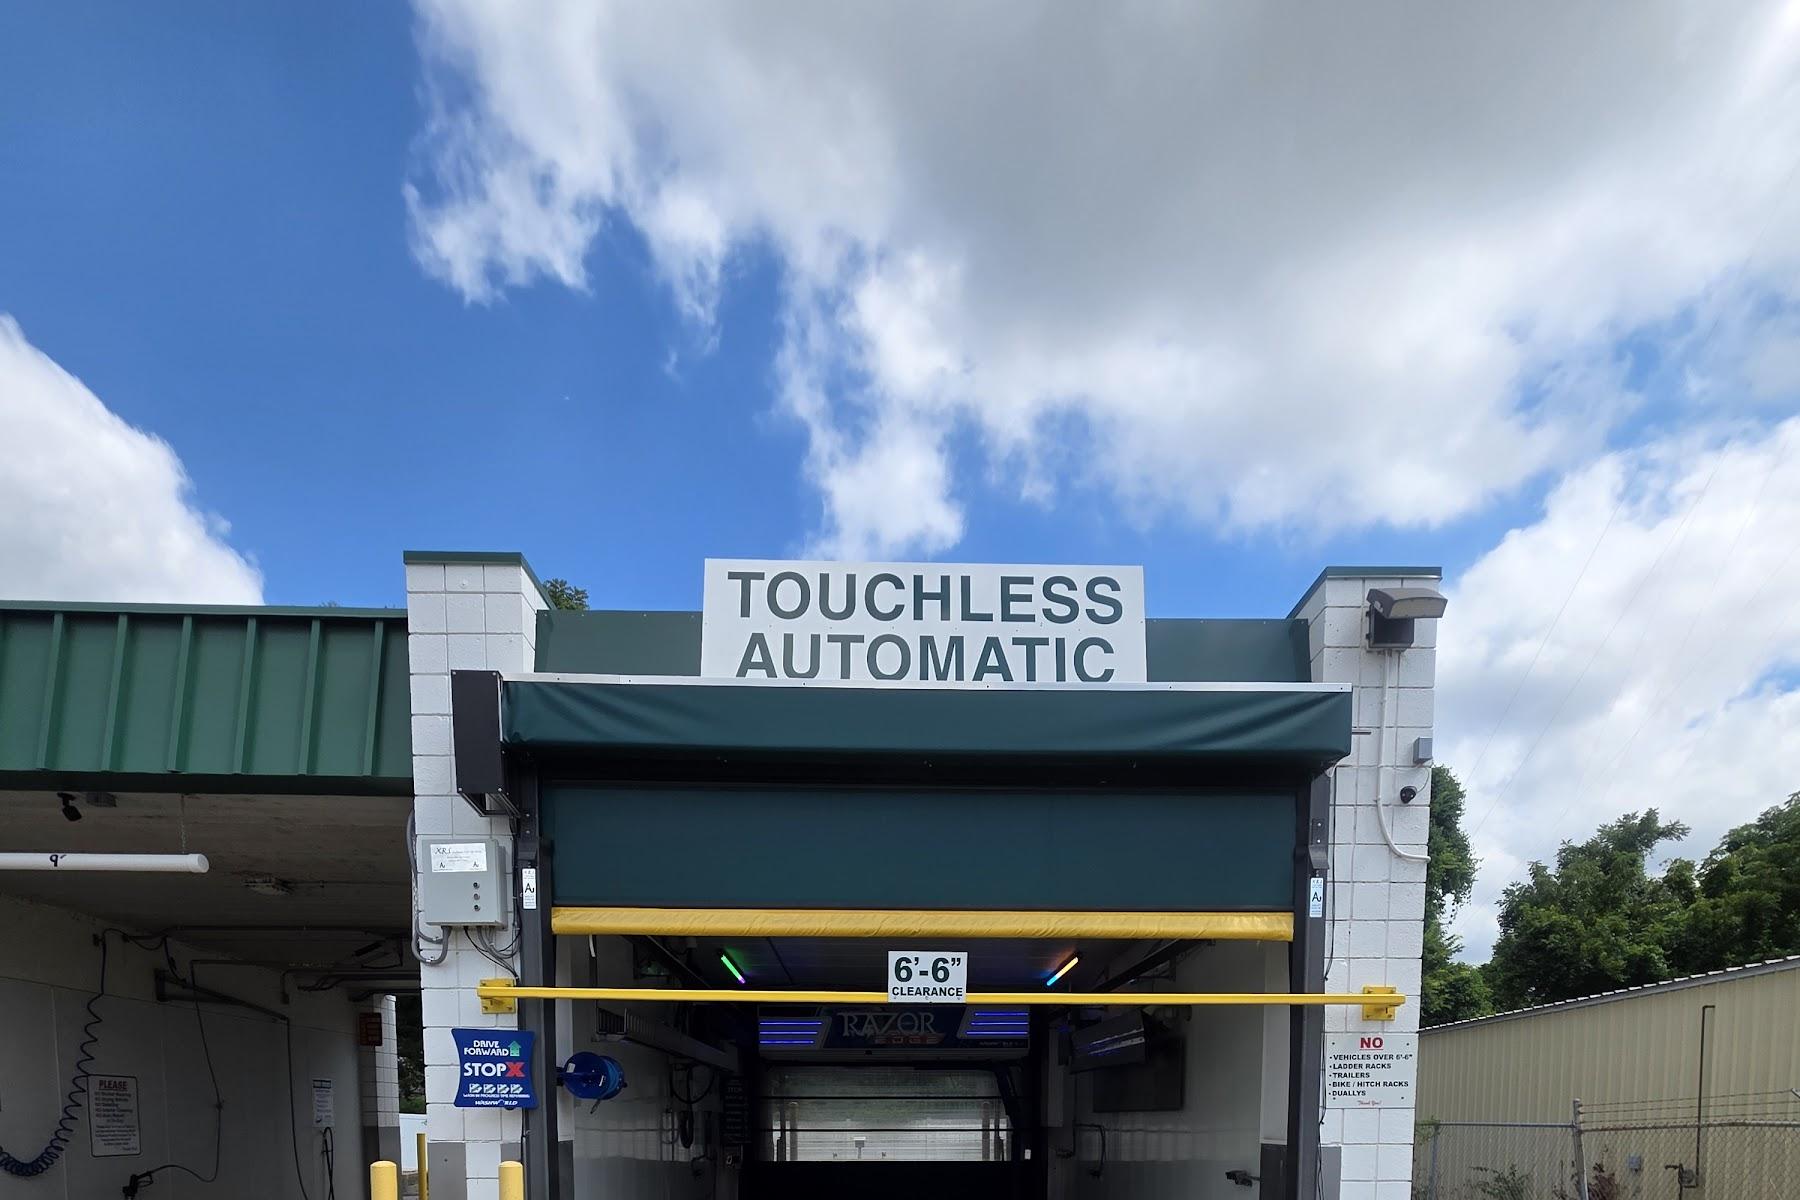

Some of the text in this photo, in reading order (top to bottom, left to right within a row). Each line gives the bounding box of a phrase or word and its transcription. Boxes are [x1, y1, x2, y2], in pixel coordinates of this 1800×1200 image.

[727, 571, 1124, 625] TOUCHLESS
[735, 632, 1116, 683] AUTOMATIC
[894, 956, 962, 983] 6'-6"
[892, 986, 963, 997] CLEARANCE
[836, 1011, 937, 1038] RAZOR
[473, 1040, 500, 1048] DRIVE
[874, 1033, 939, 1045] EDGE
[1360, 1037, 1384, 1049] NO
[464, 1048, 509, 1056] FORWARD
[463, 1062, 507, 1077] STOP
[98, 1079, 129, 1091] PLEASE
